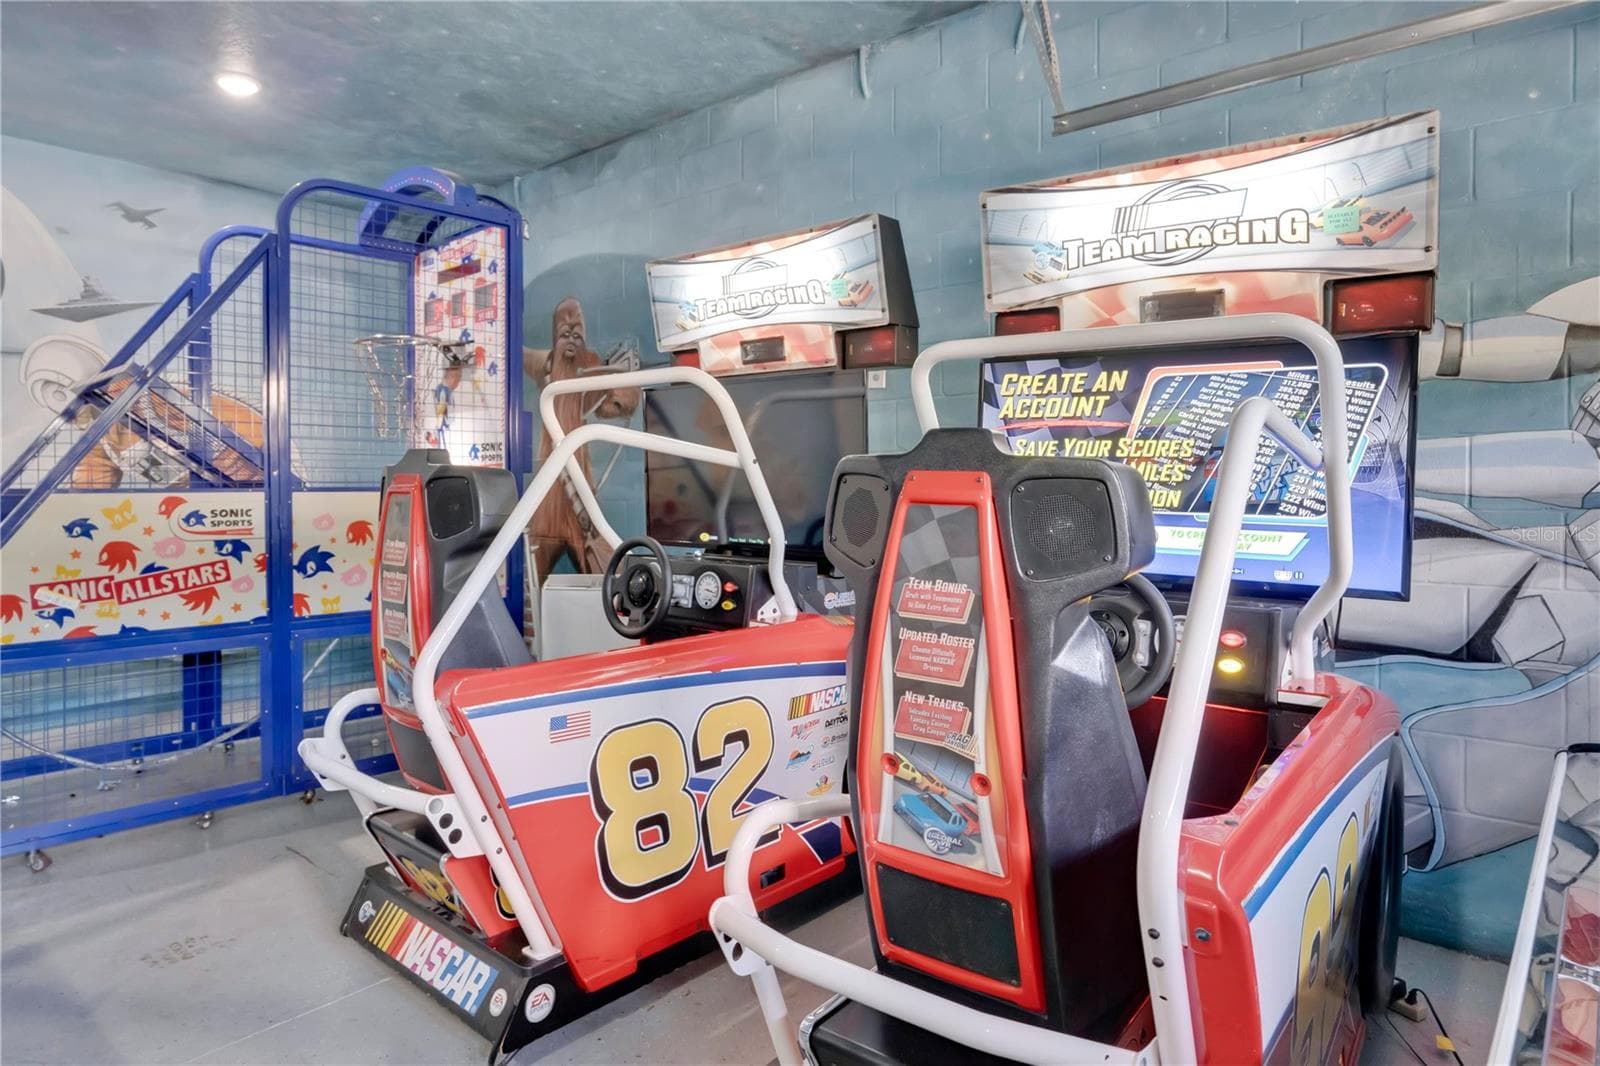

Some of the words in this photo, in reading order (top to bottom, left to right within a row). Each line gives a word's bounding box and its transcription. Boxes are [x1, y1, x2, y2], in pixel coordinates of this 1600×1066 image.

[1001, 372, 1092, 397] CREATE
[1097, 370, 1128, 392] AN
[1287, 371, 1310, 379] Miles
[1345, 380, 1376, 389] esults
[1351, 396, 1372, 406] Wins
[1354, 389, 1375, 399] Wins
[999, 394, 1110, 421] ACCOUNT
[1347, 404, 1368, 414] Wins
[1013, 439, 1060, 458] SAVE
[1063, 437, 1115, 458] YOUR
[1116, 437, 1195, 458] SCORES
[1130, 460, 1186, 482] MILES
[1284, 493, 1302, 504] 222
[1303, 498, 1326, 511] Wins
[1308, 488, 1327, 500] Win
[210, 508, 253, 519] SONIC
[1279, 502, 1297, 513] 220
[210, 519, 254, 528] SPORTS
[121, 560, 229, 602] ALLSTARS
[908, 577, 933, 591] TEAM
[934, 580, 968, 595] BONUS
[899, 627, 938, 644] UPDATED
[939, 633, 975, 649] ROSTER
[810, 684, 848, 714] NASCA
[904, 690, 925, 705] NEW
[927, 694, 964, 712] TRACKS
[590, 696, 781, 903] 82
[398, 920, 492, 1012] NASCAR
